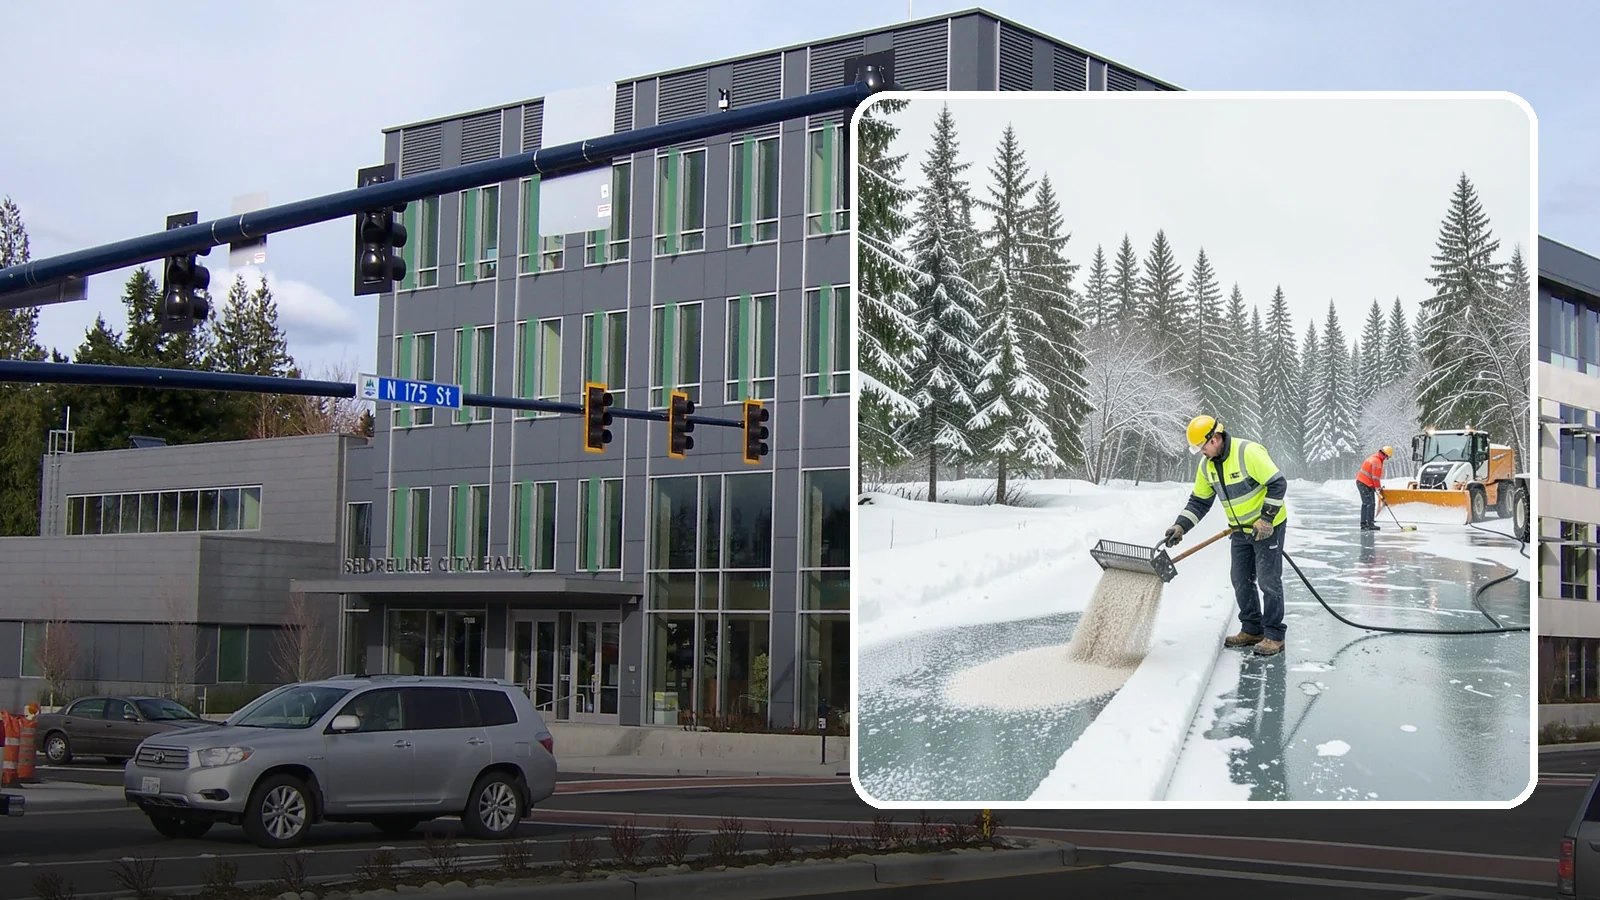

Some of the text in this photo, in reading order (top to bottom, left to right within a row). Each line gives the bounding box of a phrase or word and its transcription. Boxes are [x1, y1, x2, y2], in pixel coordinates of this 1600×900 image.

[387, 380, 451, 406] N 175 St
[344, 555, 525, 574] SHORELINE CITY HALL
